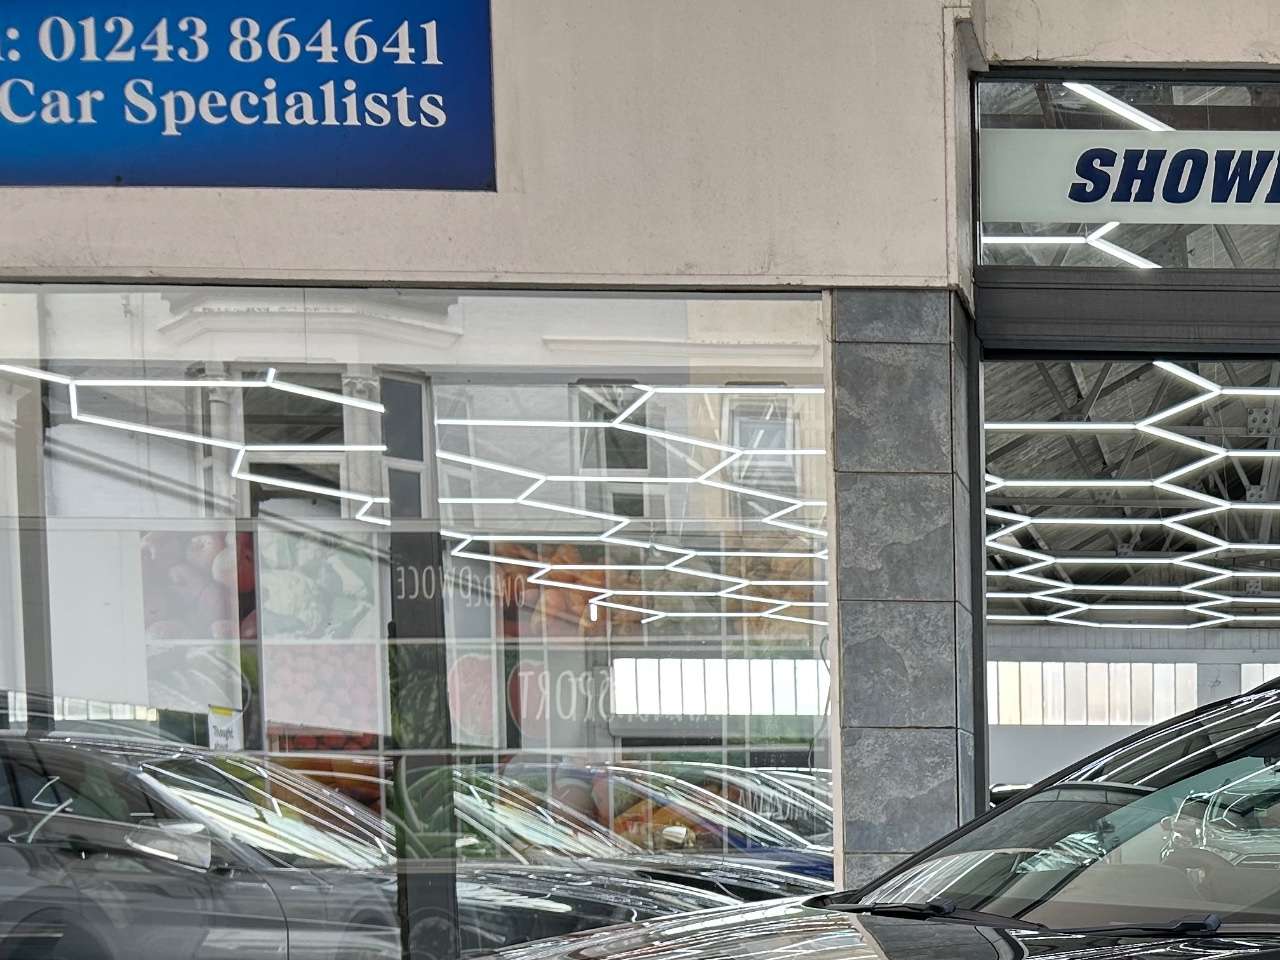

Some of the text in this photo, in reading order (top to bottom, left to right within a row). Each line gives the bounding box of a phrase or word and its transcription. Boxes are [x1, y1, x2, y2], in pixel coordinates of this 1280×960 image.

[38, 15, 209, 63] 01243
[228, 17, 444, 66] 864641
[0, 77, 448, 136] Car Specialists
